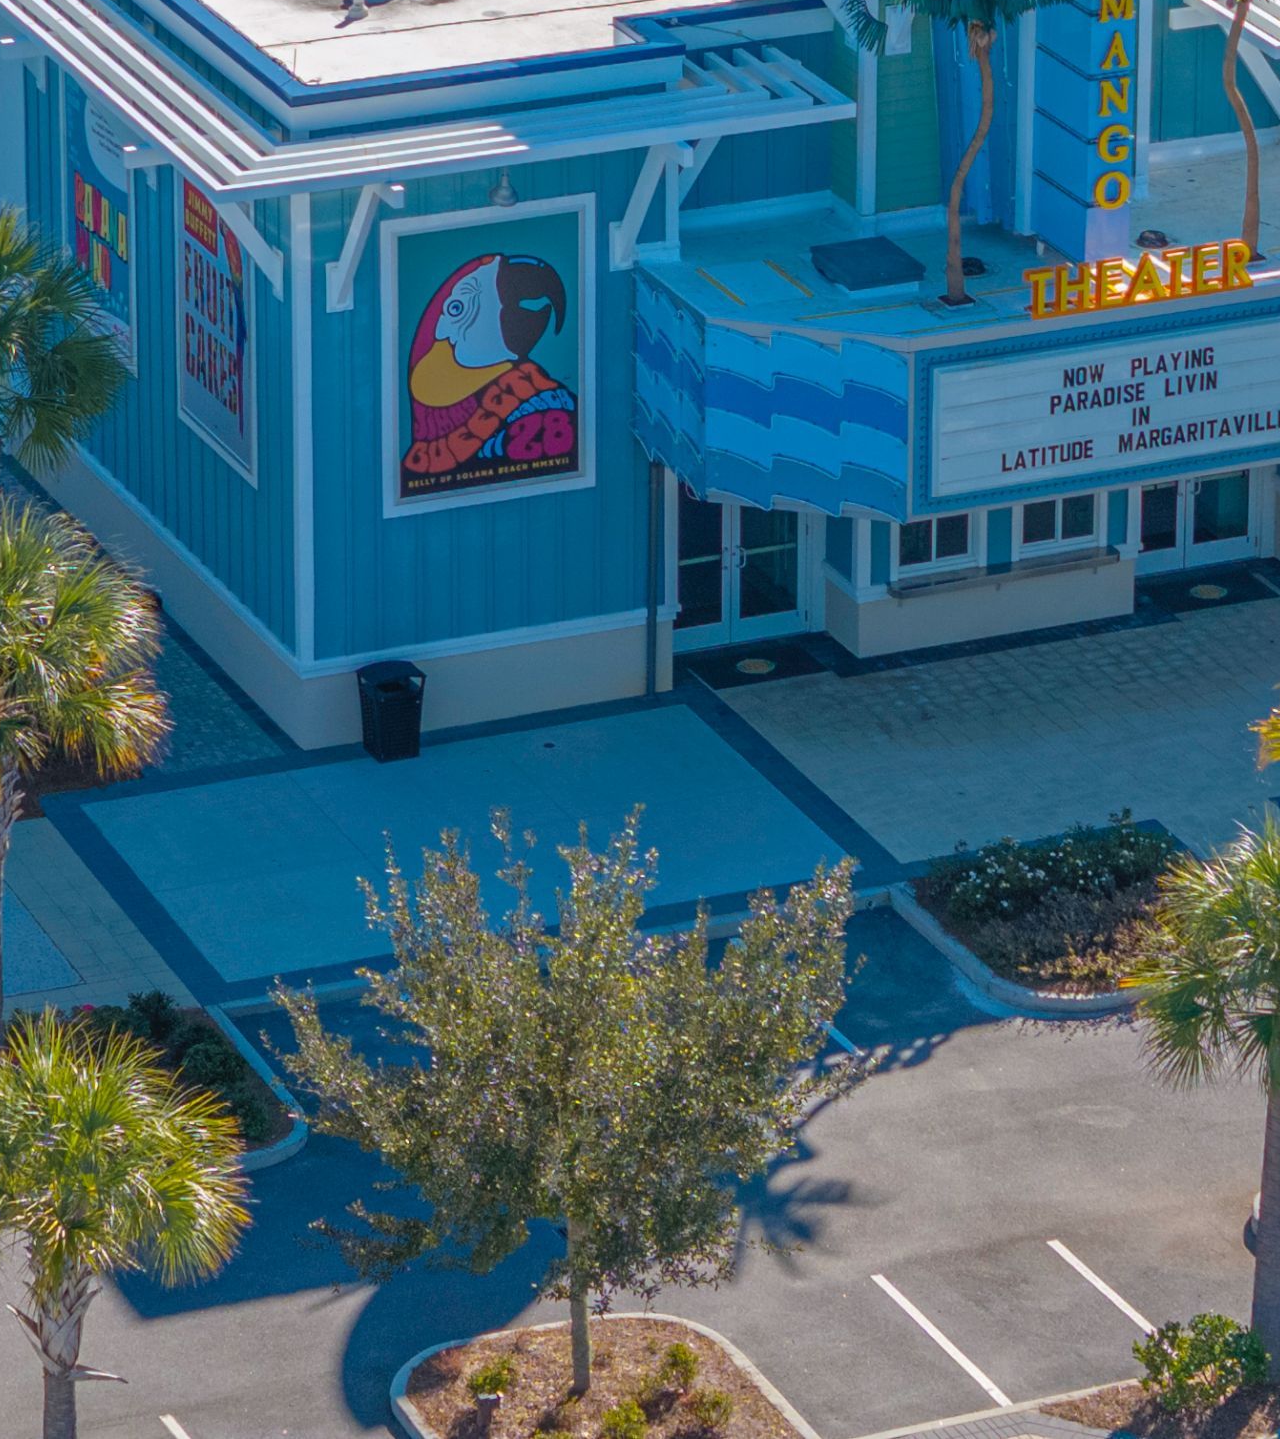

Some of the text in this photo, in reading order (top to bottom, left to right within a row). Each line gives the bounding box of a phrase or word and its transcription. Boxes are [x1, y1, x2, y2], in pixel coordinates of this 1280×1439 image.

[188, 189, 213, 223] JIMMY
[185, 208, 217, 249] BUFFETT
[184, 240, 235, 342] FRUIT
[1024, 237, 1255, 321] THEATER
[185, 311, 238, 415] CAKES
[1063, 346, 1214, 388] NOW PLAYING
[1050, 370, 1218, 415] PARADISE LIVIN
[506, 409, 574, 460] 28
[1132, 406, 1151, 427] IN
[407, 457, 569, 488] BELLY UP SOLANA BEACH MMXVII
[1001, 439, 1094, 473] LATITUDE
